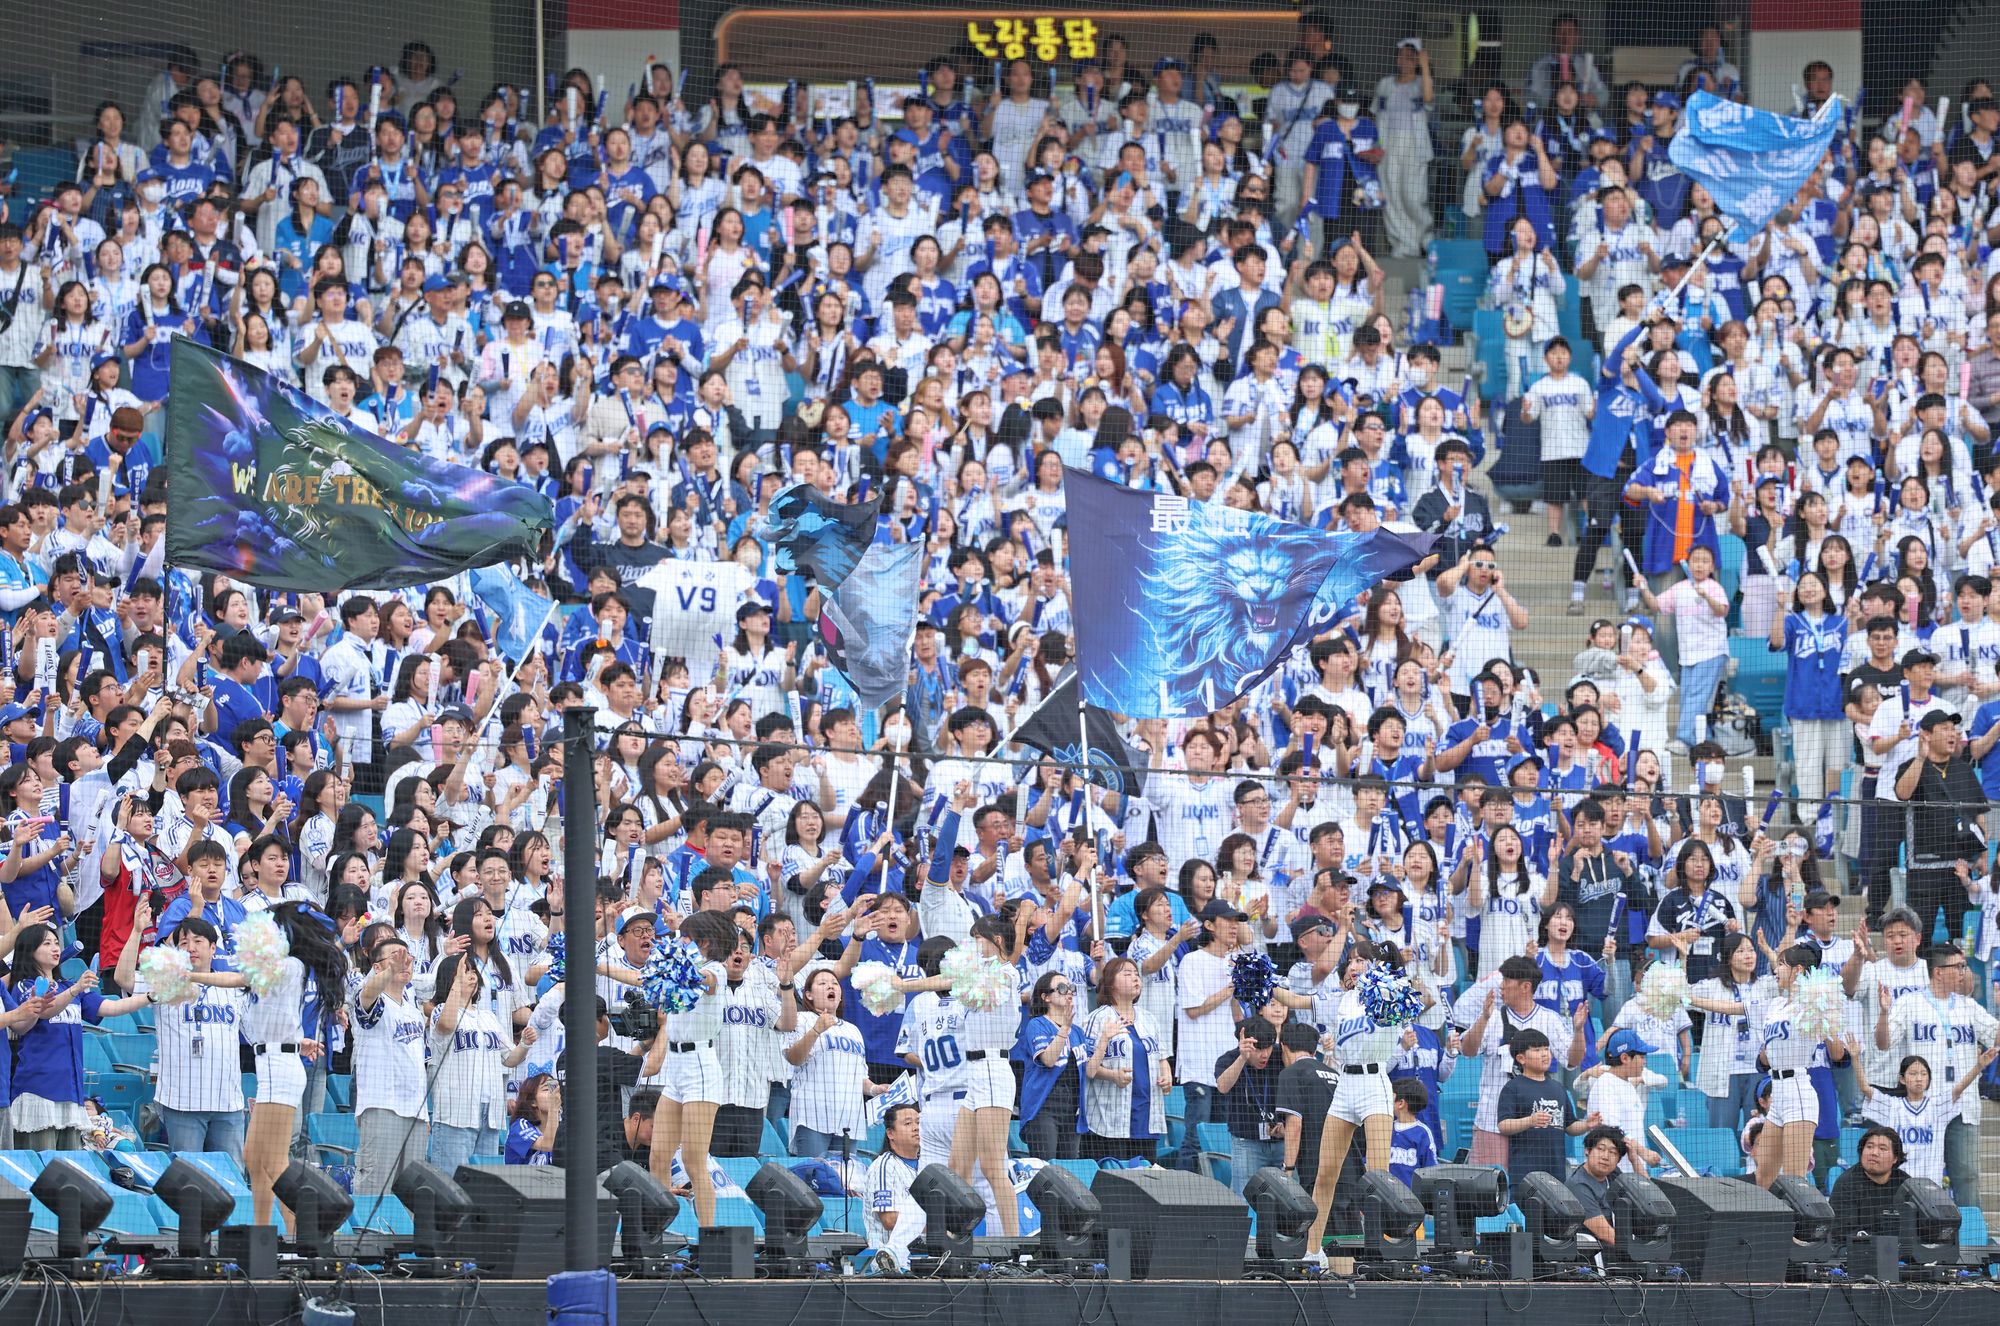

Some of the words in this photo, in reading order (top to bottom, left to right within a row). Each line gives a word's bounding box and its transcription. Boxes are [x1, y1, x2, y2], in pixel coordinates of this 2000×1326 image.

[262, 472, 320, 505] ARE
[676, 586, 717, 613] V9
[45, 644, 54, 672] Lions
[1950, 643, 1998, 661] LINS
[1488, 896, 1536, 914] LIOS
[183, 1003, 236, 1025] LONS
[924, 1034, 962, 1071] 00
